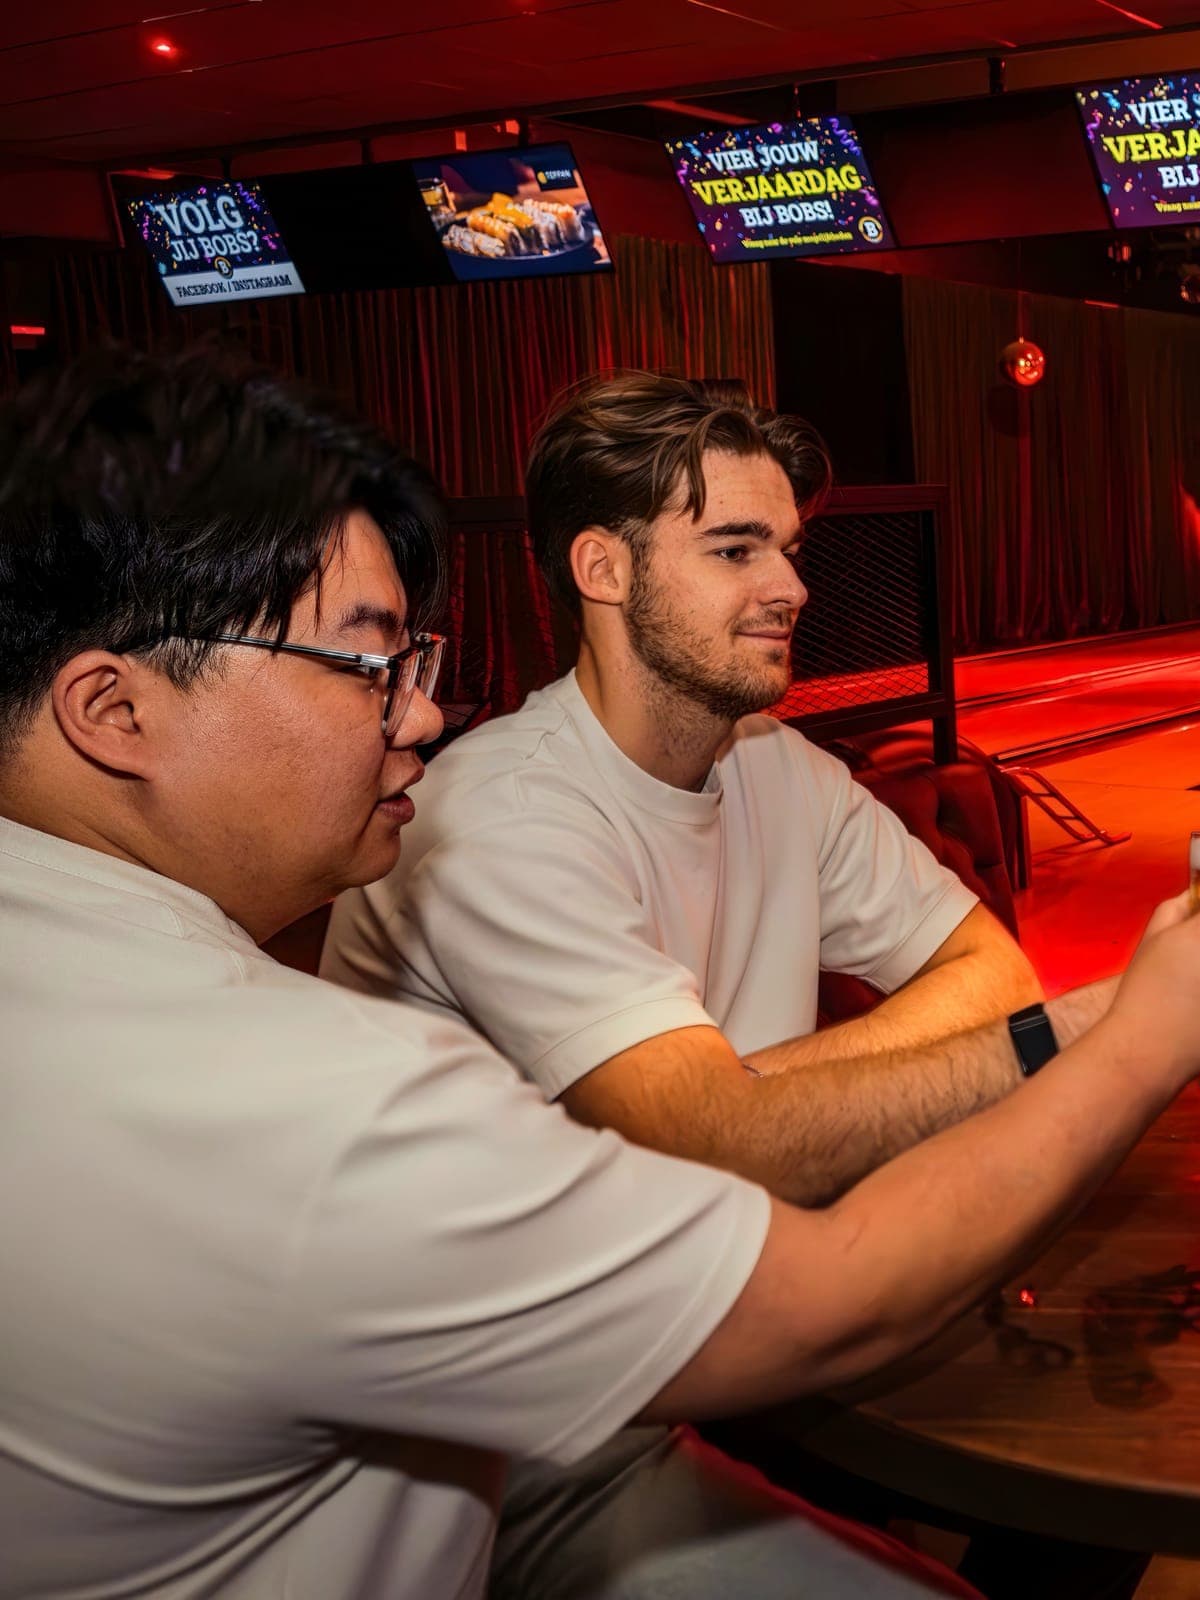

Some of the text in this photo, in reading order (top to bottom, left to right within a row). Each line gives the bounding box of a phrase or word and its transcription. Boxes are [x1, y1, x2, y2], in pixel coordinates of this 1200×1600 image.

[1127, 100, 1192, 126] VIER
[705, 140, 820, 172] VIER JOUW
[691, 165, 863, 206] VERJAARDAG
[1158, 164, 1200, 189] BIJ
[155, 195, 245, 237] VOLG
[738, 199, 835, 229] BIJ BOBS!
[170, 230, 261, 262] JIJ BOBS?
[175, 281, 228, 298] FACEBOOK
[232, 274, 293, 292] INSTAGRAM
